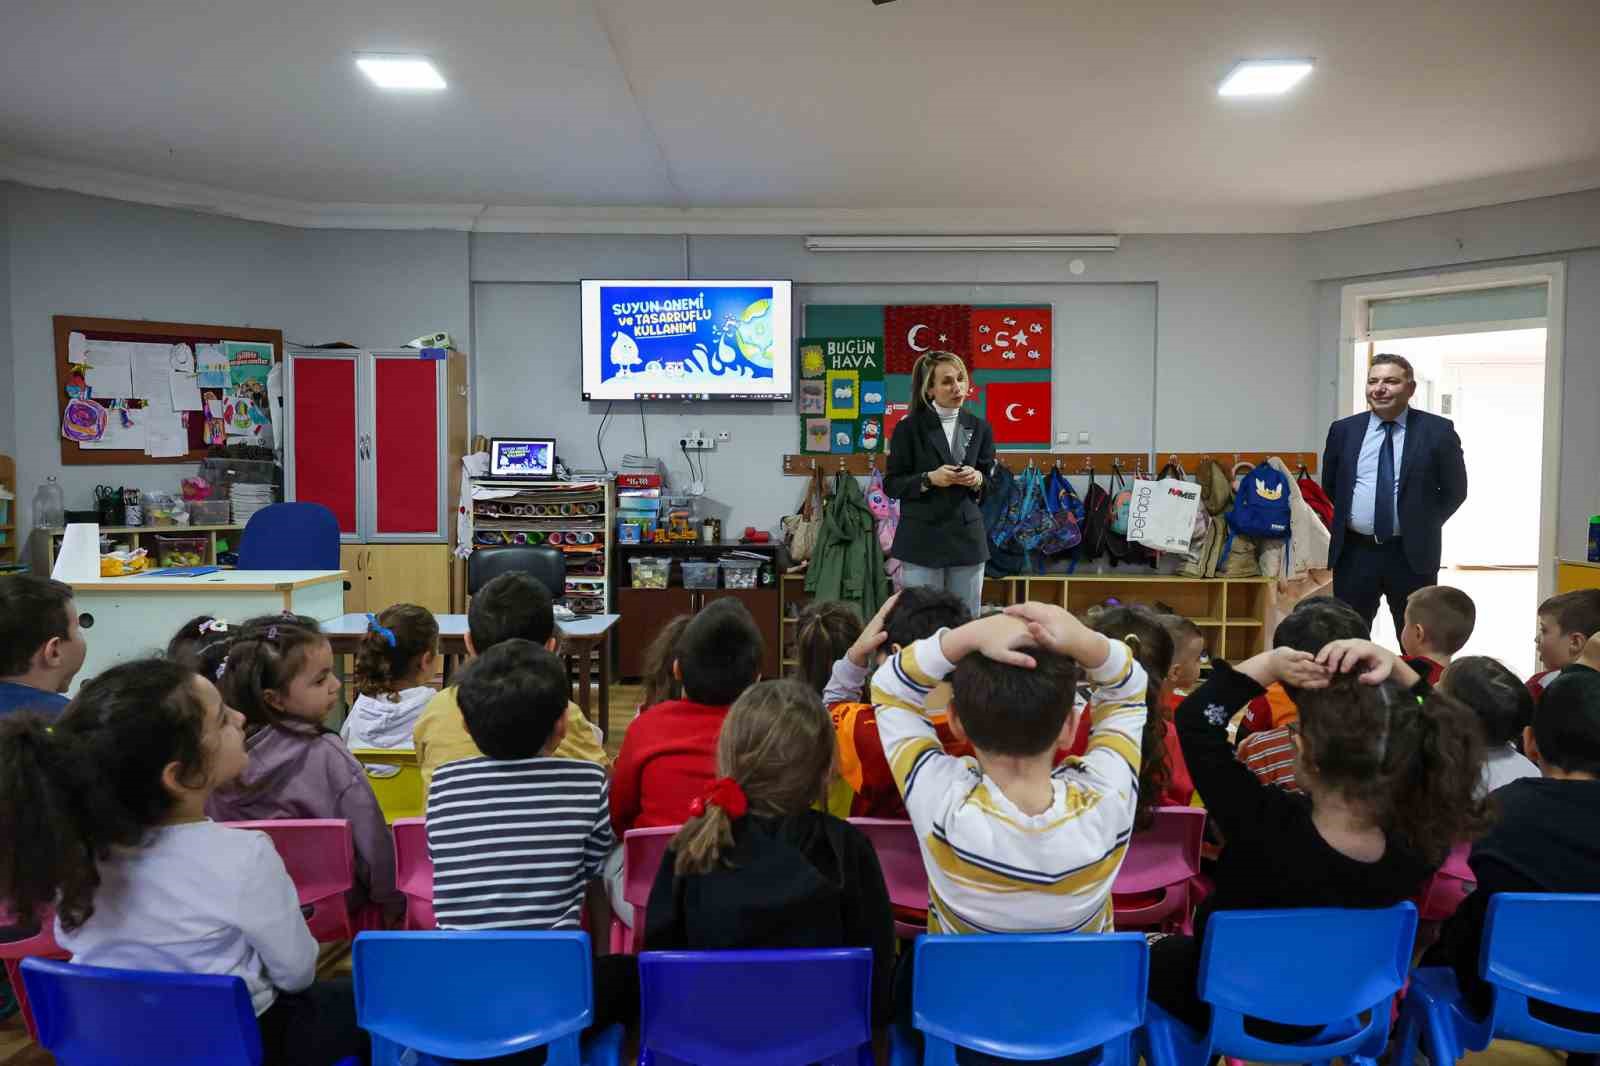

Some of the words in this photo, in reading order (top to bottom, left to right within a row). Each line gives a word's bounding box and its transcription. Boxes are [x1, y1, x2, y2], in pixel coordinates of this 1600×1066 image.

[612, 301, 660, 315] SUYUN
[619, 317, 633, 326] ve
[635, 309, 712, 325] TASARRUFLU
[634, 322, 696, 337] KULLANIMI
[827, 340, 875, 355] BUGÜN
[832, 355, 876, 369] HAVA
